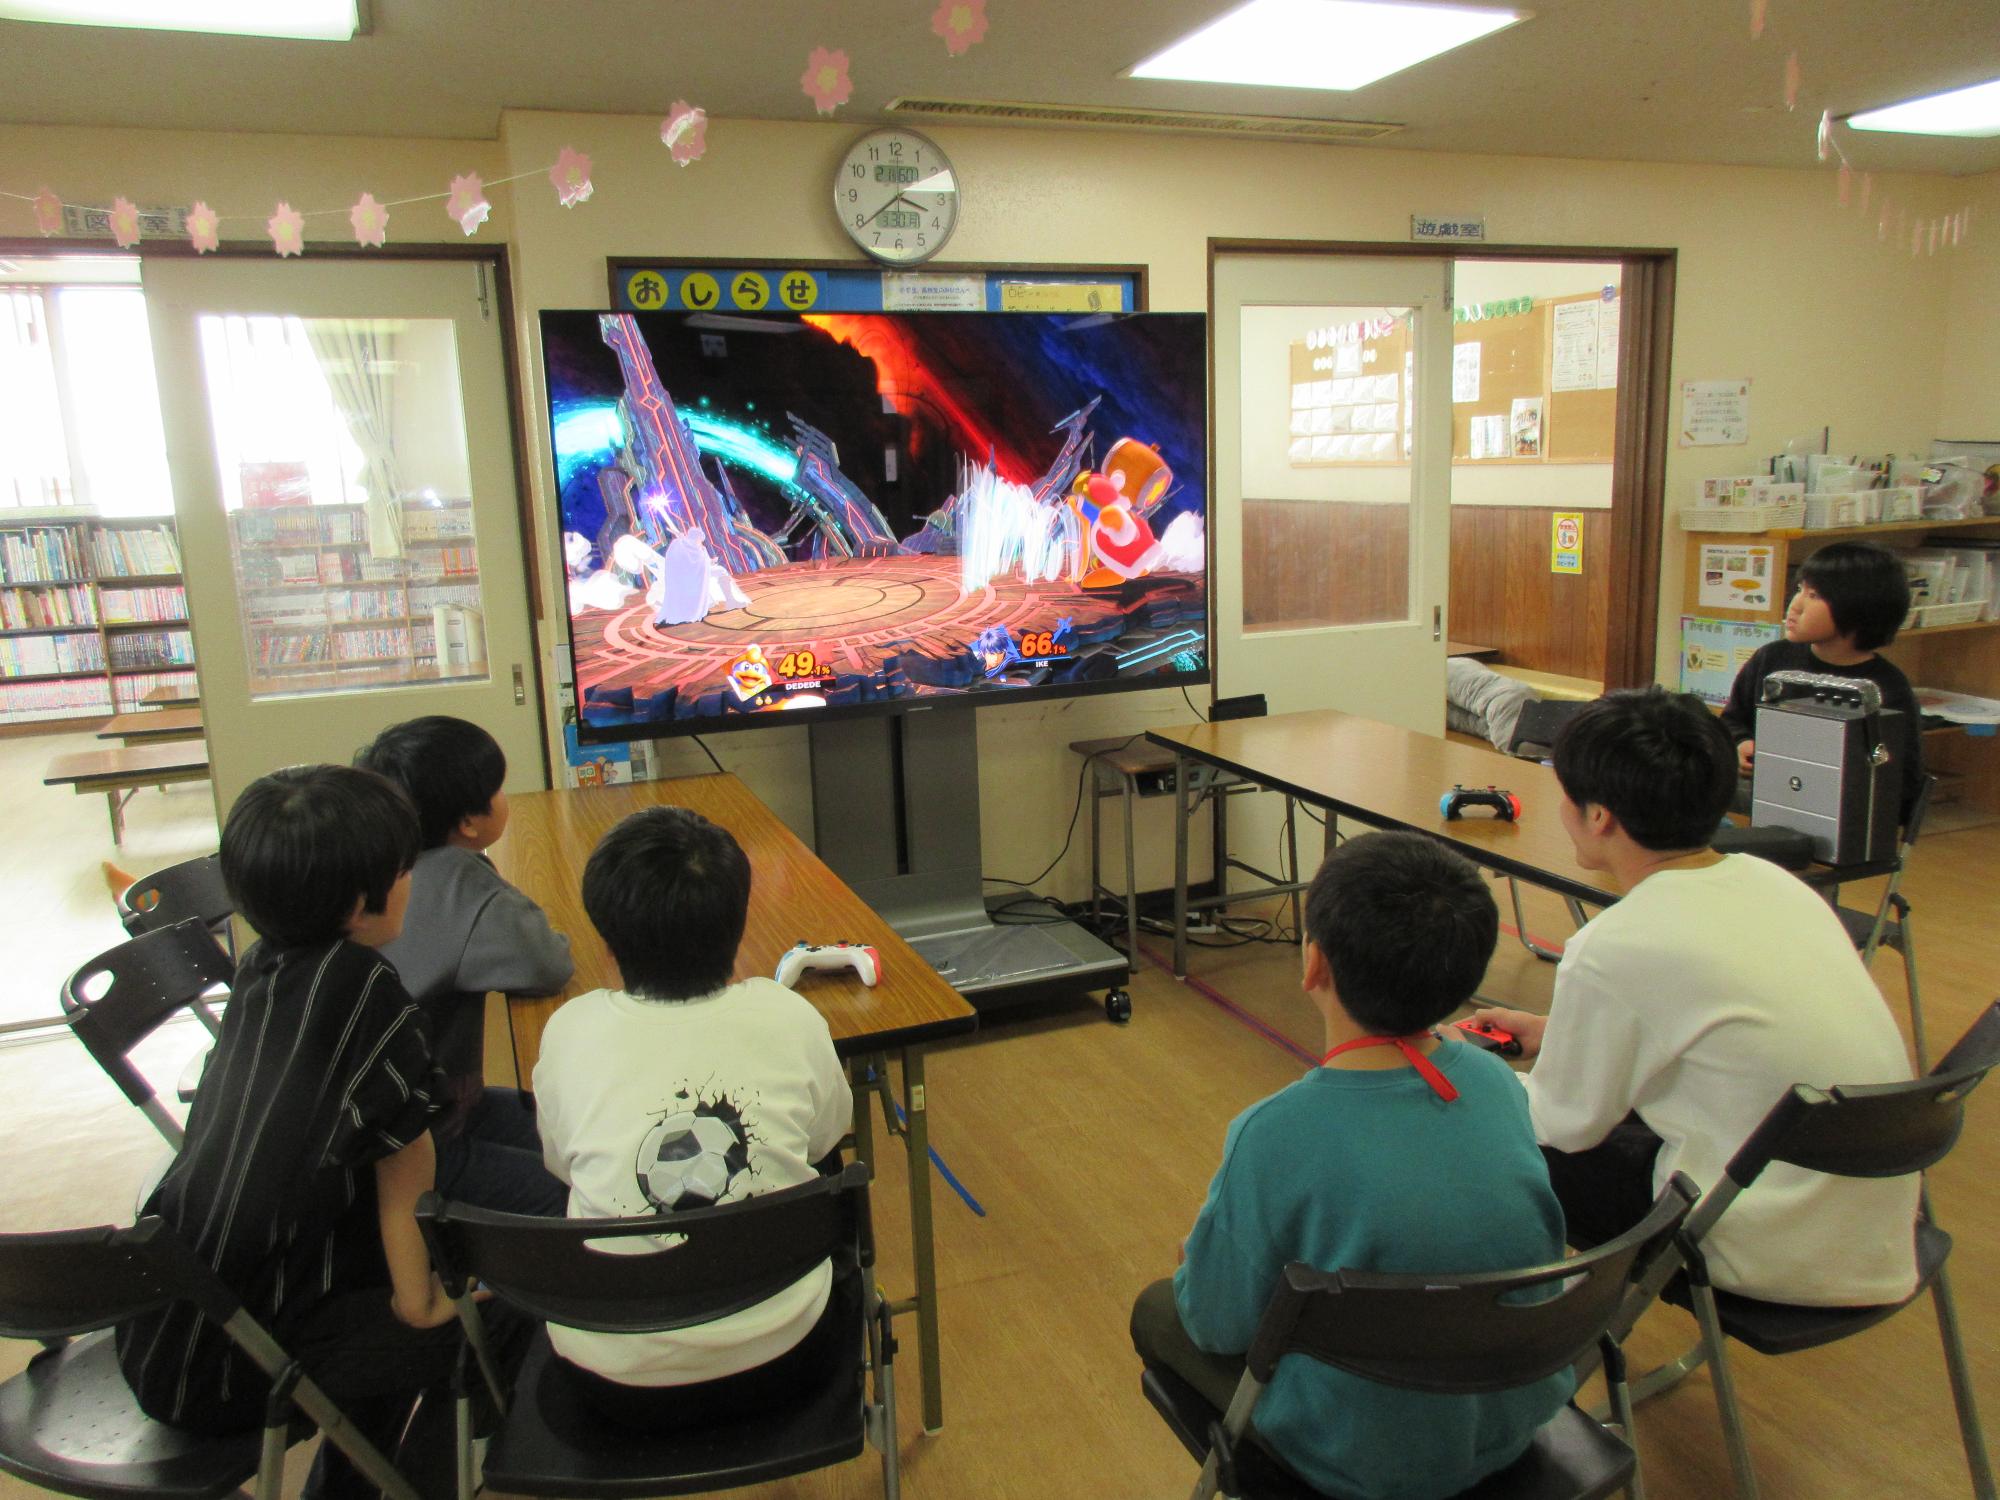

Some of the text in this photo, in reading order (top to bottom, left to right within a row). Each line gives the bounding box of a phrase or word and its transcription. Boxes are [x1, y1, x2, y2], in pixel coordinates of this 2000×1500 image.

[869, 147, 879, 161] 11
[889, 142, 902, 156] 12
[852, 163, 865, 178] 10
[849, 189, 857, 202] 9
[937, 193, 946, 206] 3
[856, 213, 865, 228] 8
[931, 216, 941, 231] 4
[1416, 221, 1480, 237] 遊戯室
[873, 231, 880, 245] 7
[917, 233, 926, 247] 5
[634, 277, 811, 307] おしらせ
[1034, 660, 1049, 668] IKE
[785, 680, 821, 691] DEDEDE
